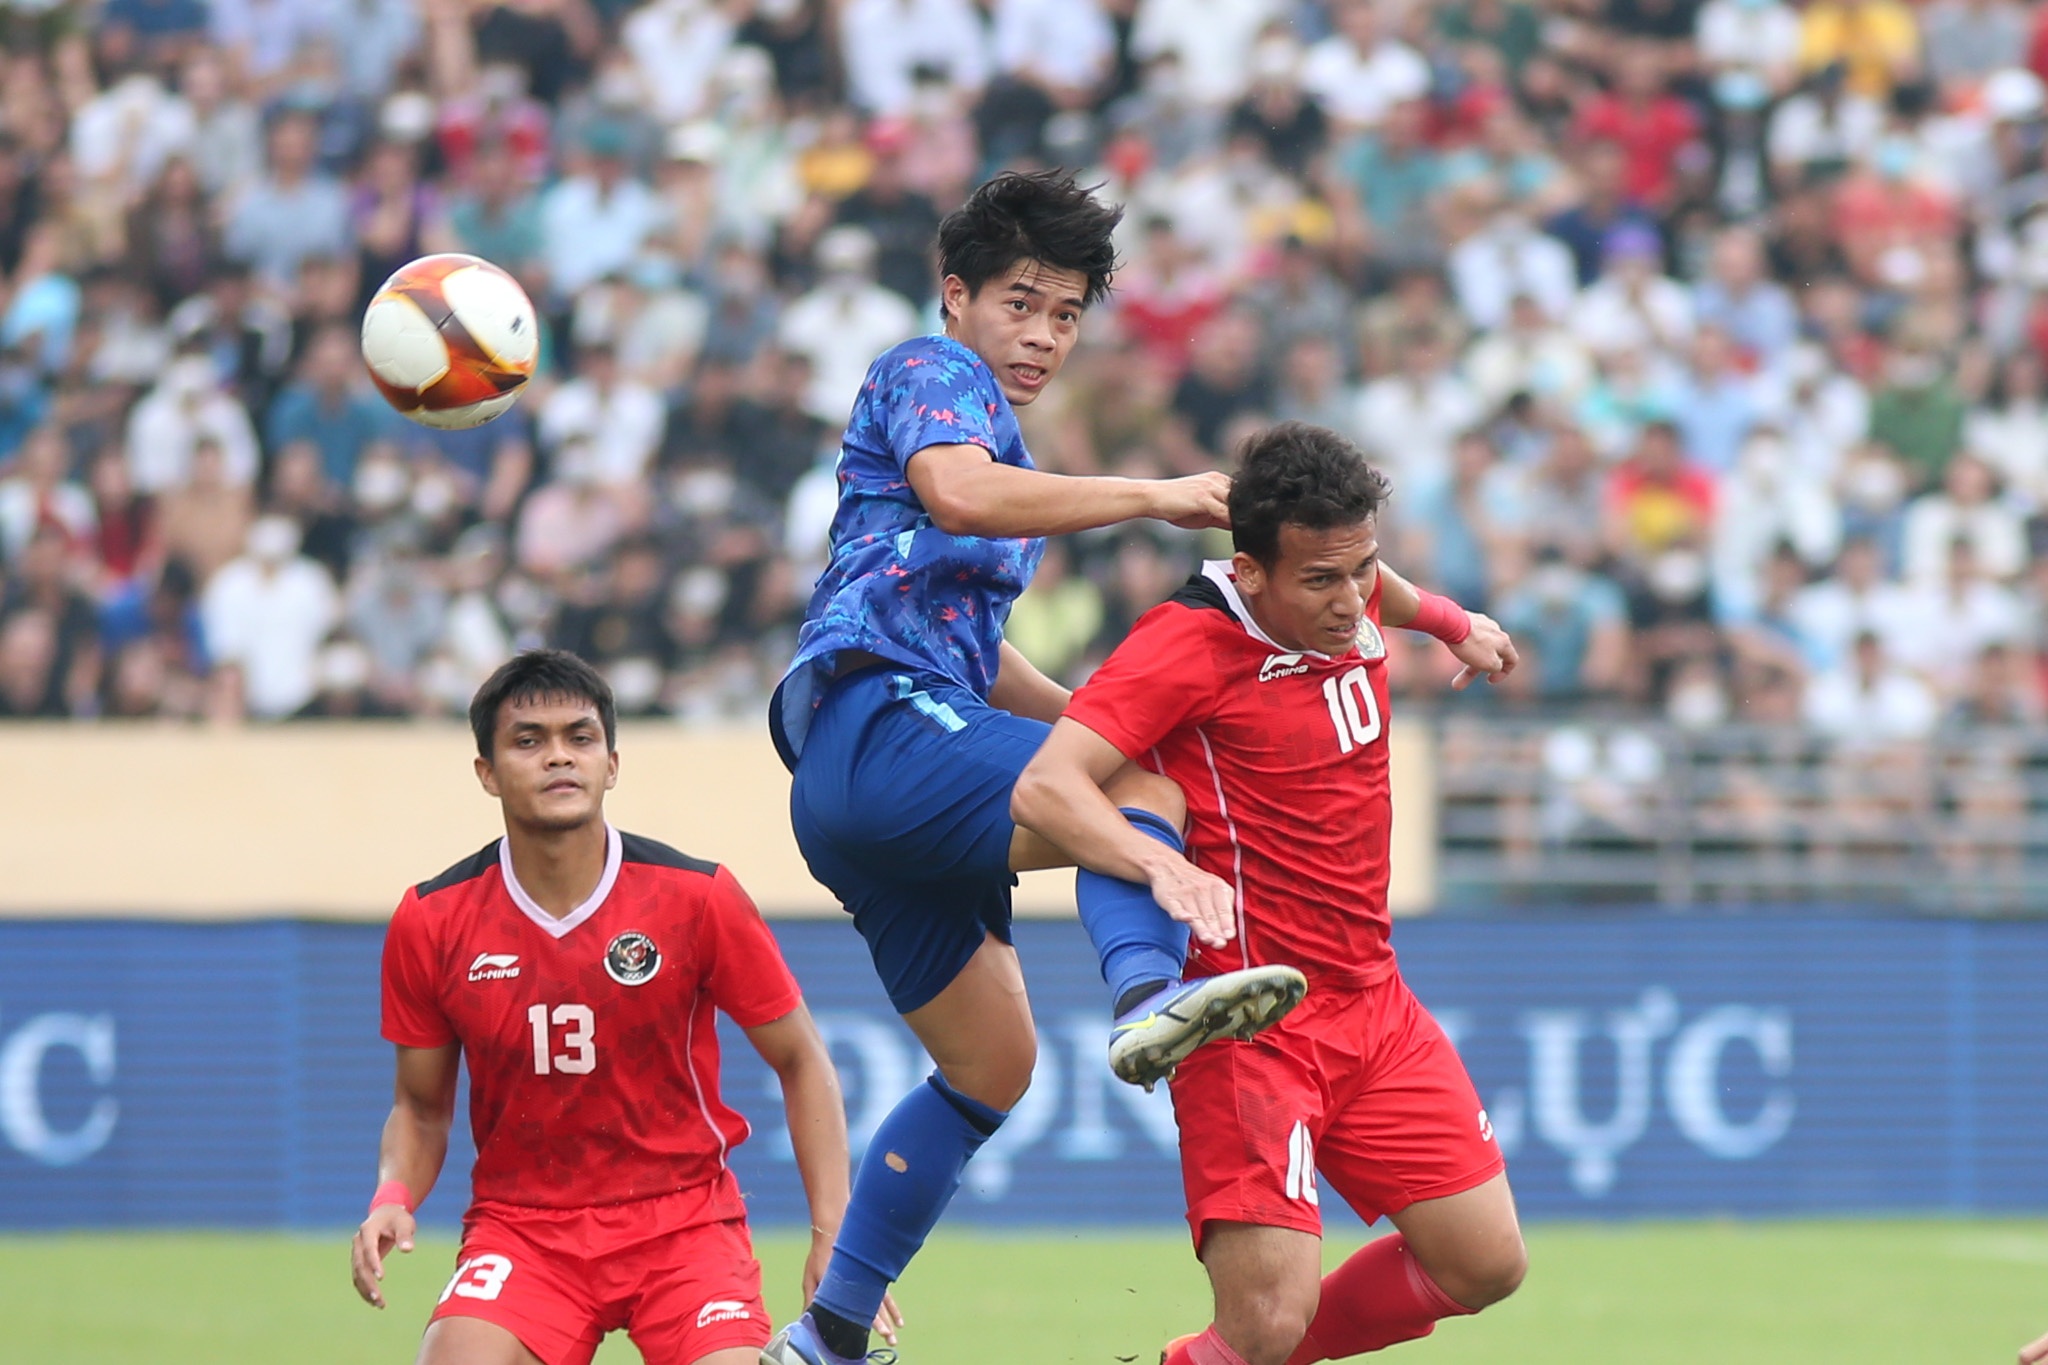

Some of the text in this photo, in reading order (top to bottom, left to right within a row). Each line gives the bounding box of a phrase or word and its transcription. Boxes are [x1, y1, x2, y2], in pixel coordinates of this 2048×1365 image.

[1258, 664, 1309, 682] LI-NING
[1322, 665, 1382, 754] 10
[468, 967, 520, 982] LI-NING
[528, 1004, 596, 1075] 13
